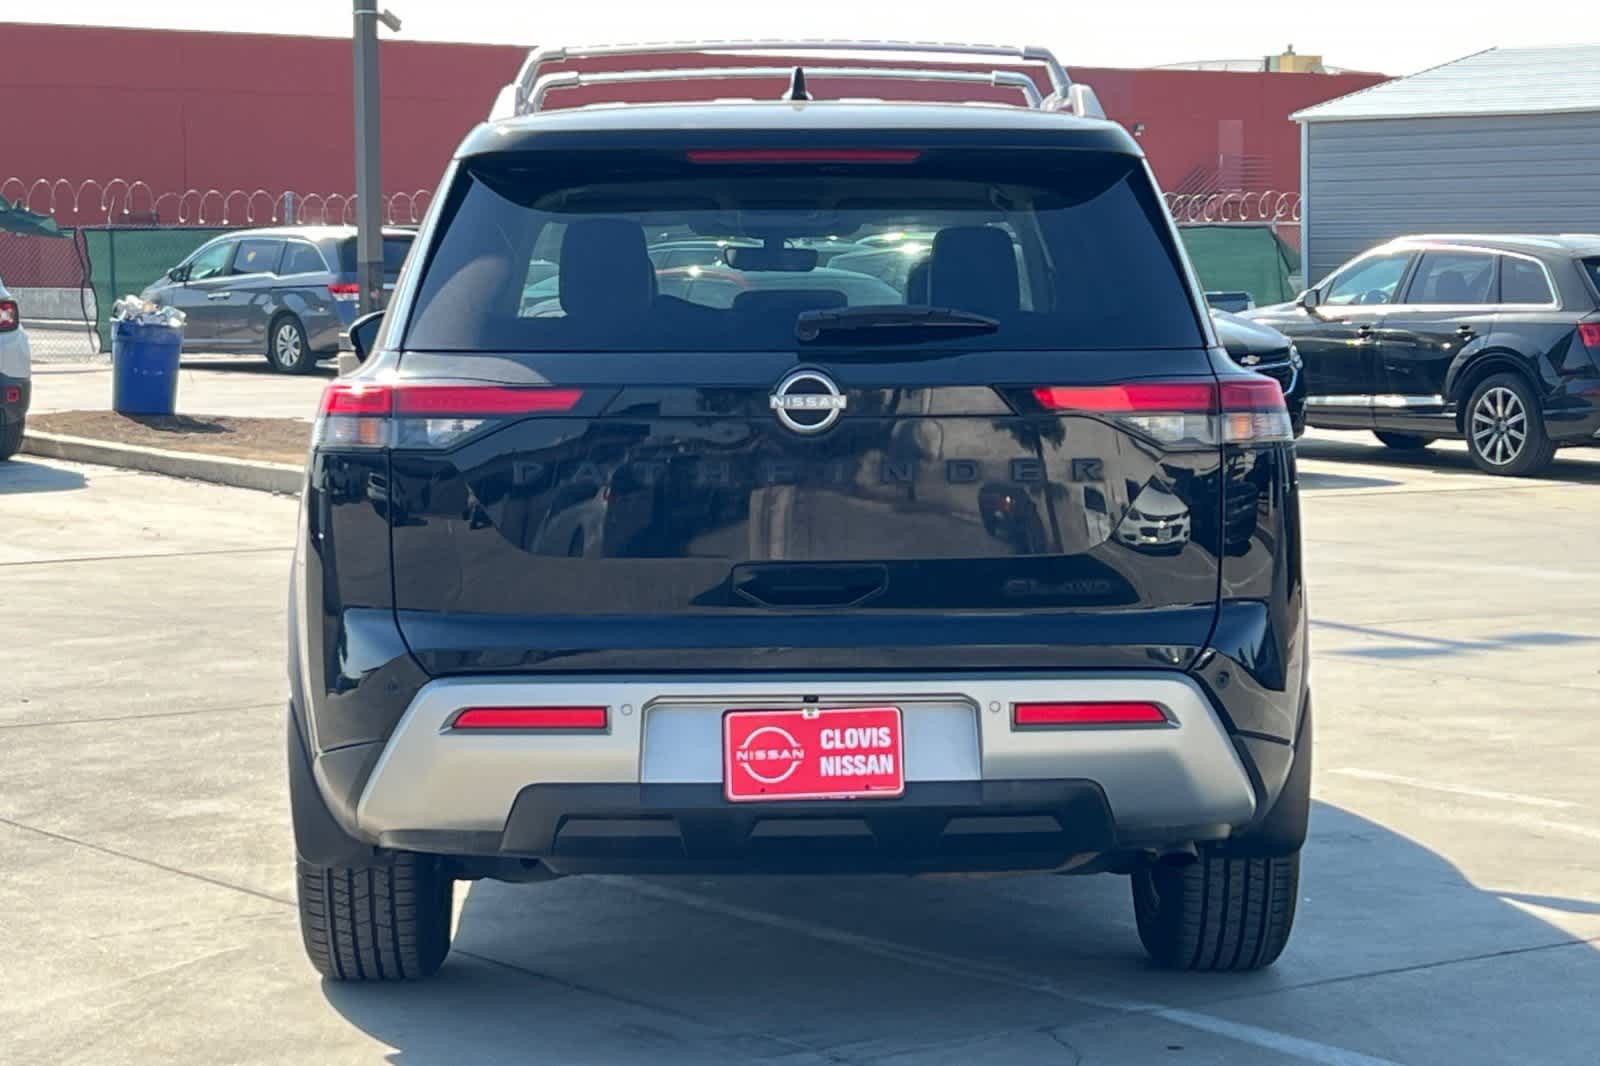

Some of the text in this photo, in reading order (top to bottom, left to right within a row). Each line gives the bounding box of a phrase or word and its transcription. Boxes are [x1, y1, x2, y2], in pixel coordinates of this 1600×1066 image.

[770, 396, 847, 409] NISSAN
[512, 457, 1105, 486] PATHFINDER
[820, 727, 892, 749] CLOVIS
[736, 749, 805, 760] NISSAN
[820, 754, 894, 777] NISSAN
